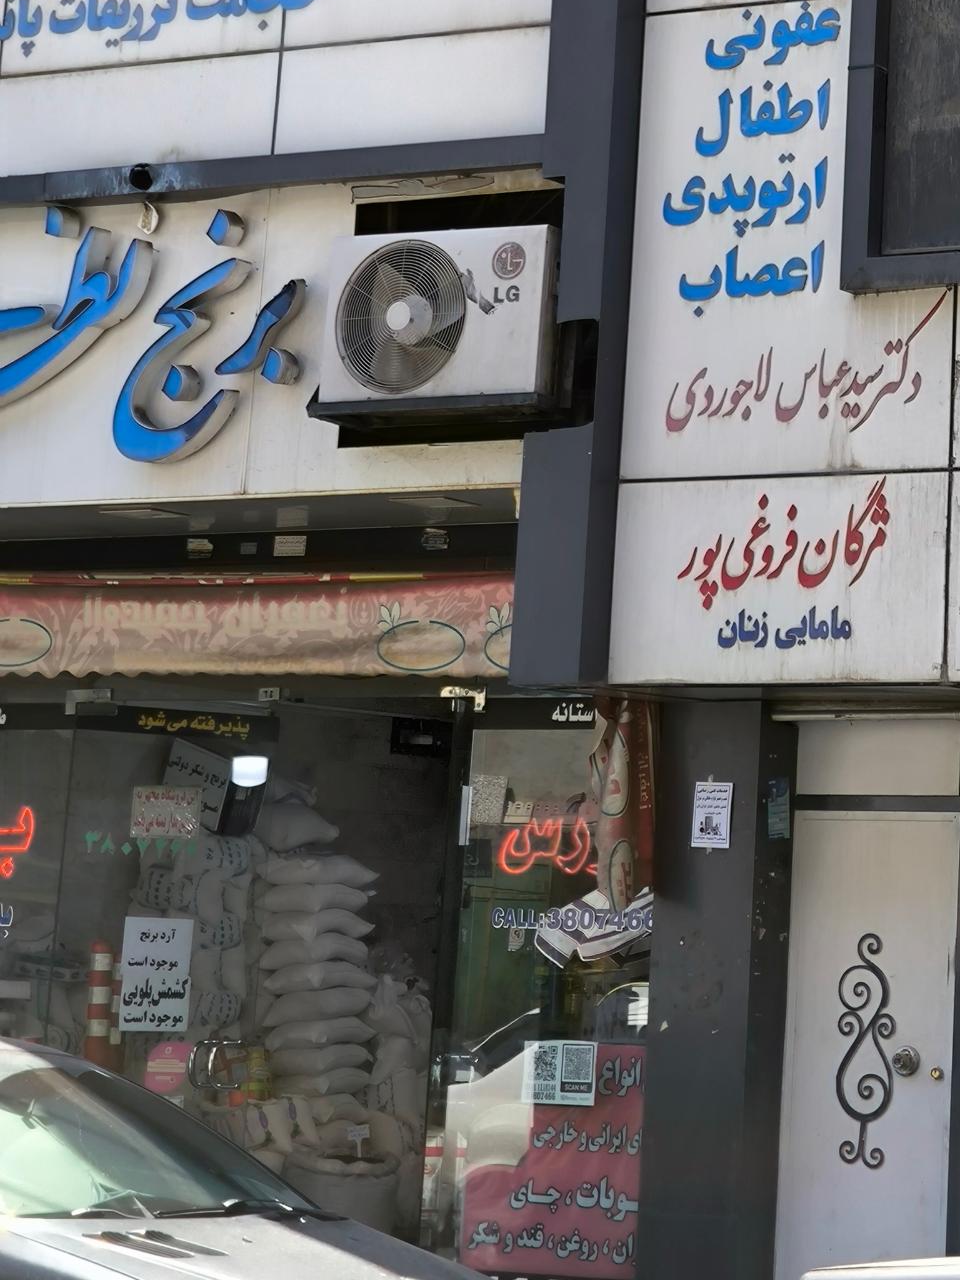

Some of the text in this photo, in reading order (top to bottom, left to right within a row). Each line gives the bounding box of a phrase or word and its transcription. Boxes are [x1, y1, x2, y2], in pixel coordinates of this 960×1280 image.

[705, 1, 842, 70] عفونی
[694, 78, 831, 157] اطفال
[662, 153, 828, 236] ارتوپدی
[493, 285, 519, 303] LG
[678, 240, 824, 318] اعصاب
[113, 208, 306, 464] برنج
[665, 346, 773, 432] لاجوردی
[775, 348, 851, 423] عباس
[798, 476, 890, 588] مژگان
[717, 605, 852, 650] مامایی زنان
[139, 928, 177, 944] آرد برنج
[127, 956, 179, 972] موجود است
[123, 1010, 184, 1028] موجود است
[599, 1055, 642, 1097] انواع
[532, 1120, 578, 1150] خارجی
[509, 1177, 561, 1213] چای
[468, 1220, 500, 1249] شکر
